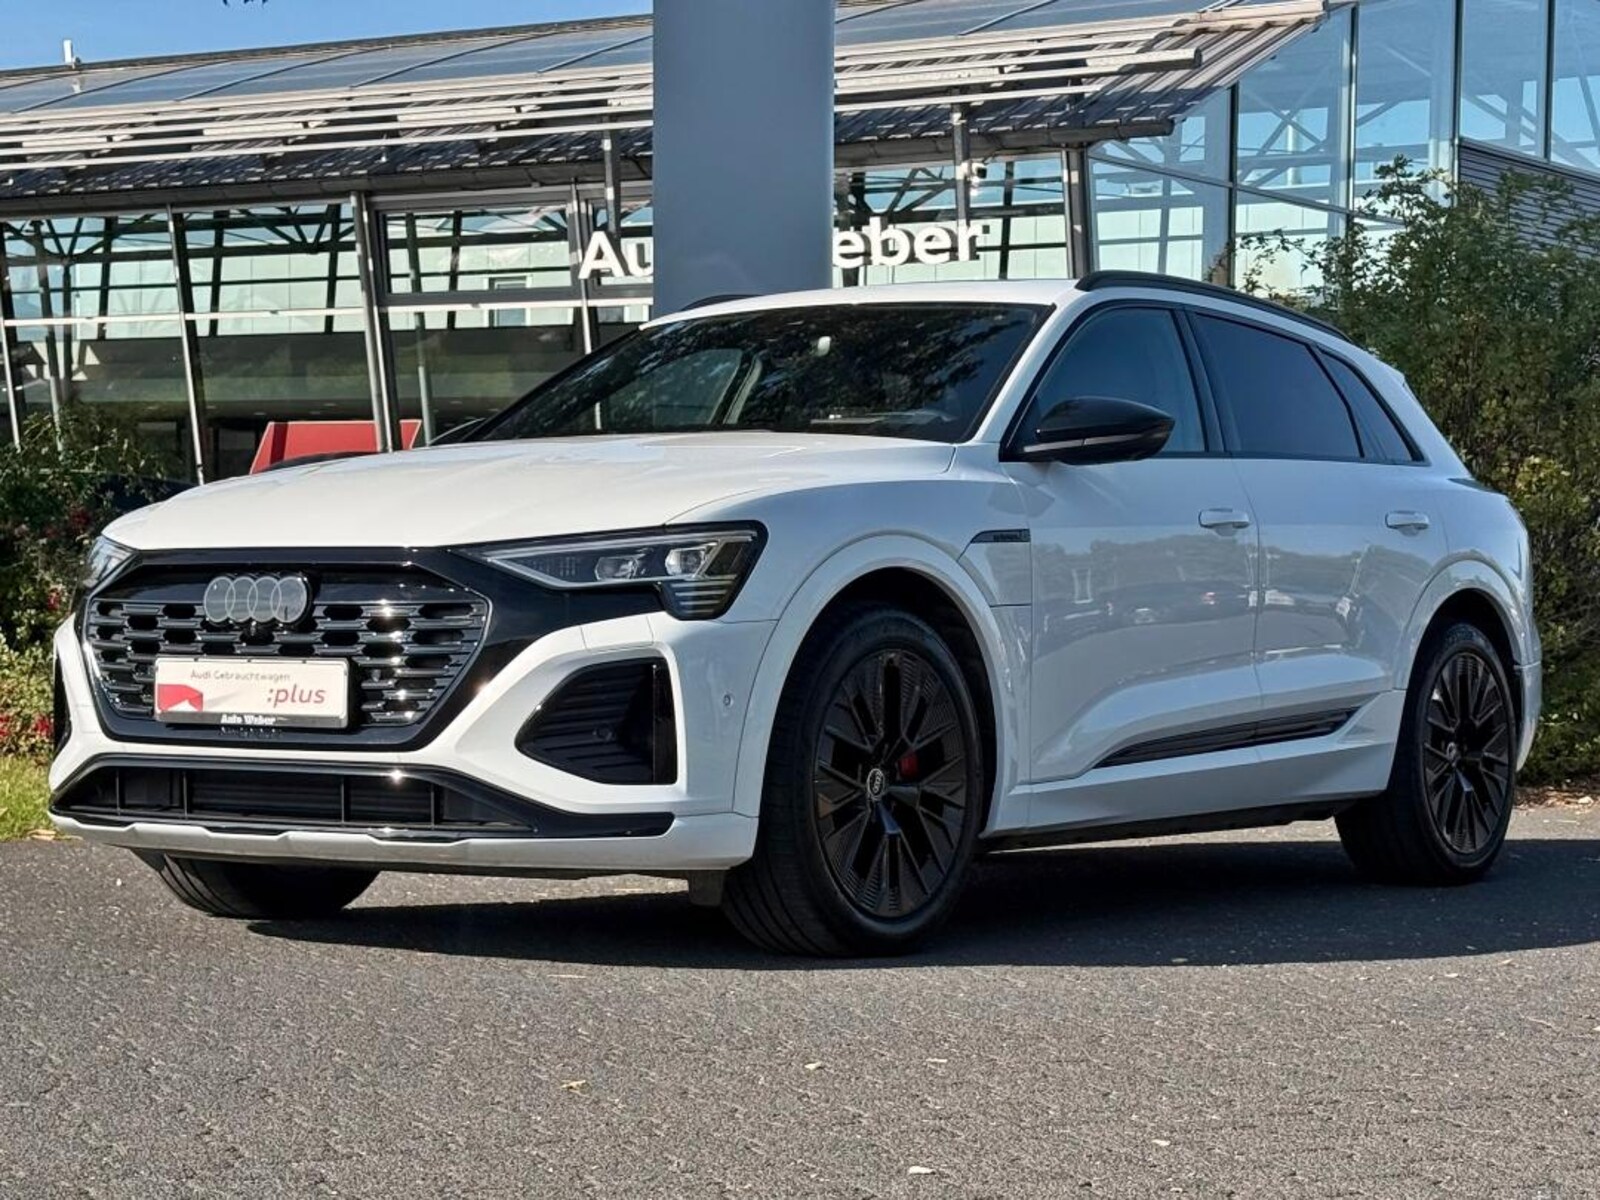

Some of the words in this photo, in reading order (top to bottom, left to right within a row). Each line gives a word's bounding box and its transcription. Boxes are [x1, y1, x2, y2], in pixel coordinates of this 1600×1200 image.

[578, 230, 654, 280] Au
[832, 216, 980, 269] eber
[190, 669, 212, 680] Audi
[213, 669, 290, 683] Gebrauchtwagen
[266, 684, 326, 708] :plus
